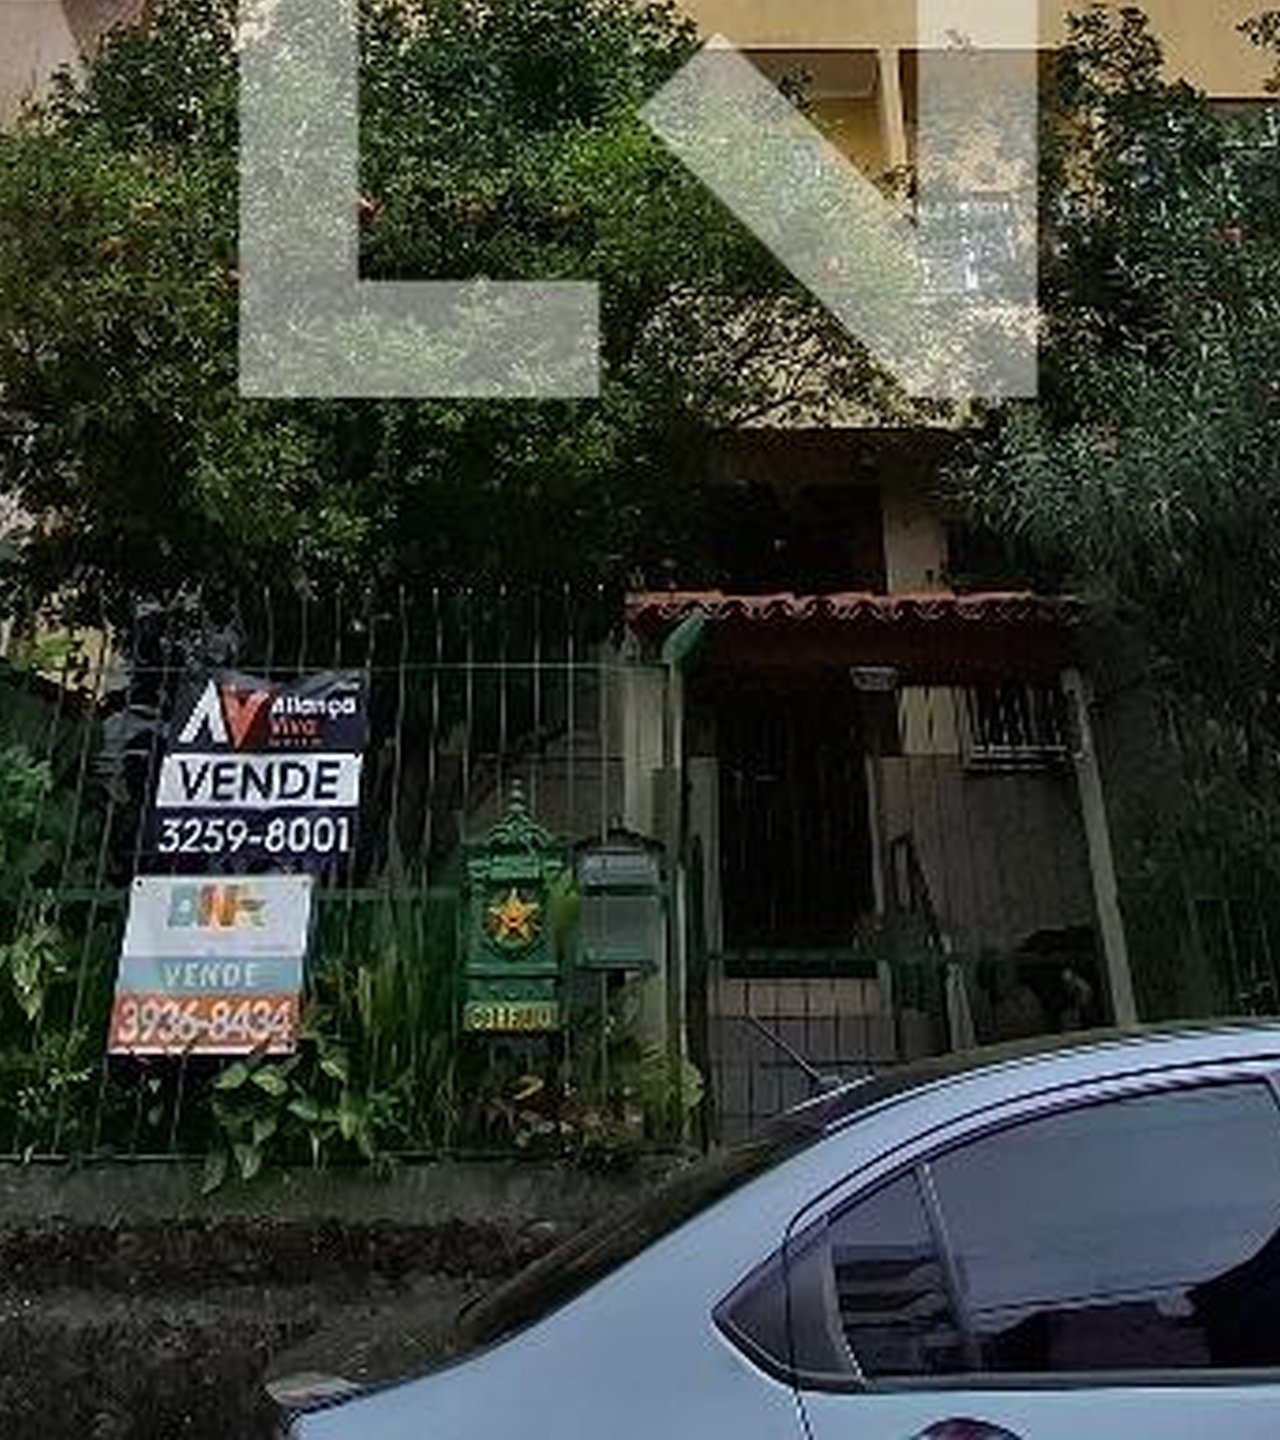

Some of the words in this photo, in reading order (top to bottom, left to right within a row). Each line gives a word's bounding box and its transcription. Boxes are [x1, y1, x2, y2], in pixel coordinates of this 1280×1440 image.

[272, 697, 356, 718] Aliança
[179, 762, 340, 800] VENDE
[158, 816, 349, 853] 3259-8001
[163, 962, 262, 987] VENDE
